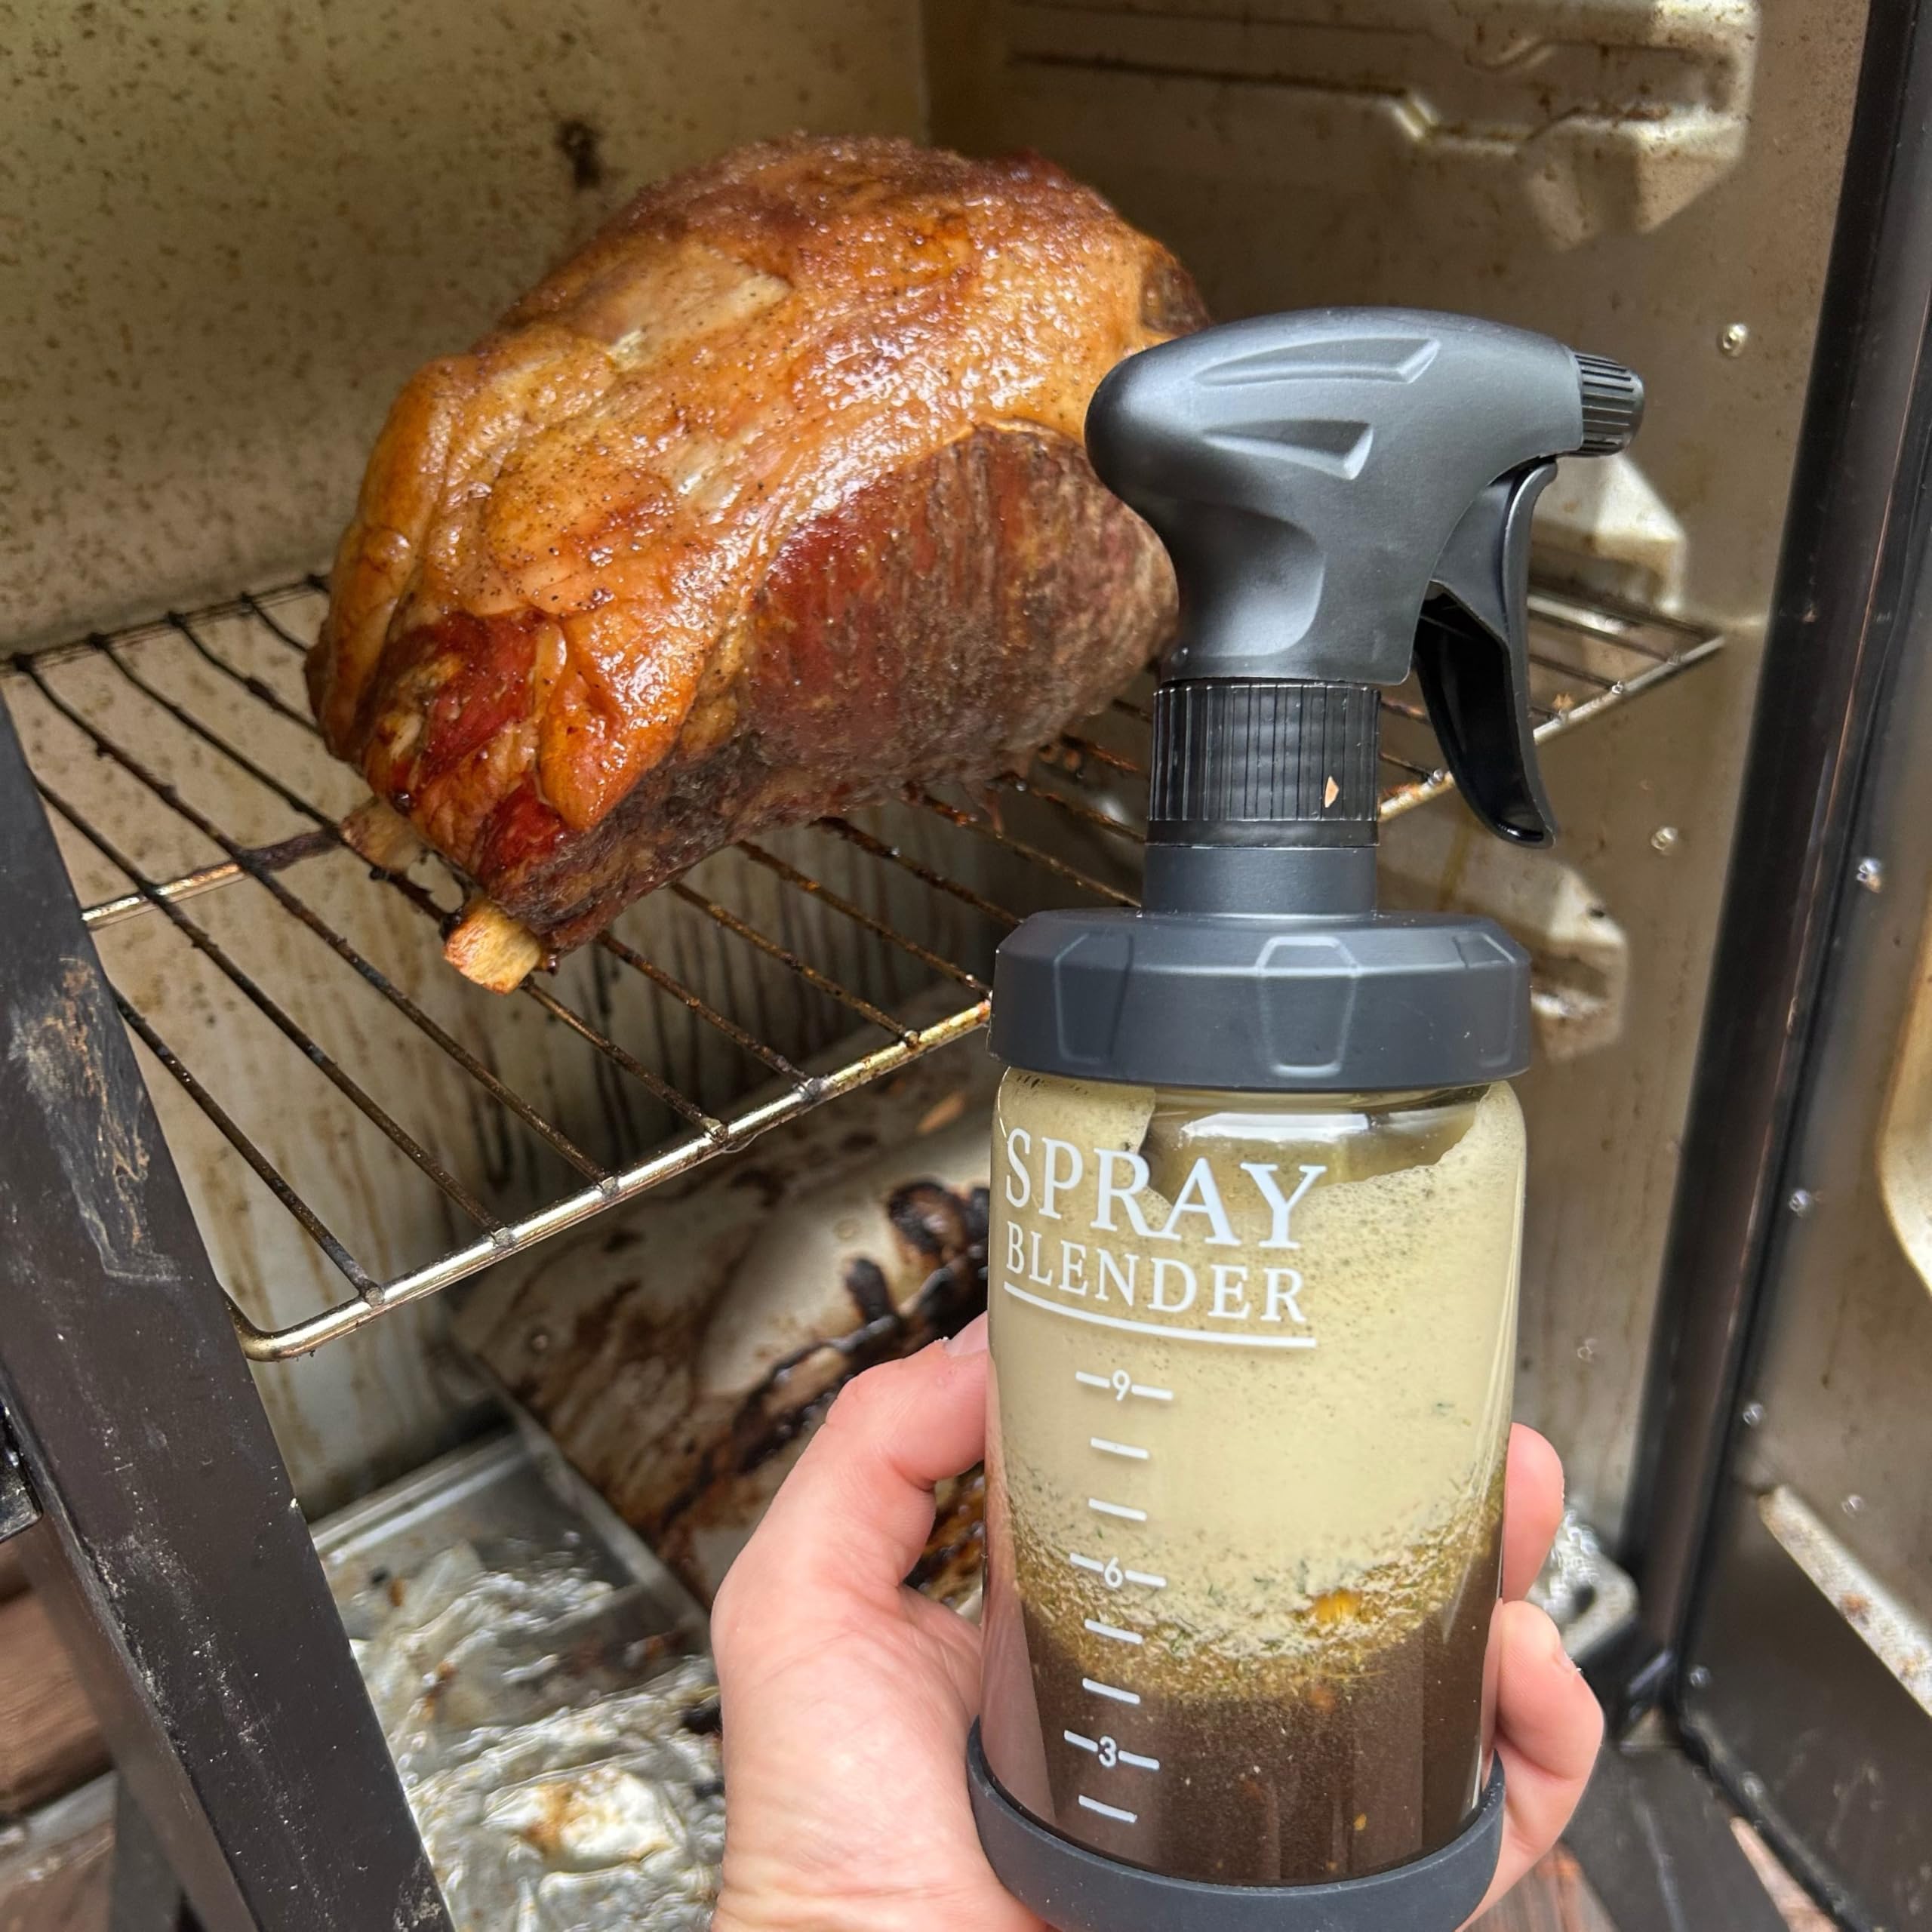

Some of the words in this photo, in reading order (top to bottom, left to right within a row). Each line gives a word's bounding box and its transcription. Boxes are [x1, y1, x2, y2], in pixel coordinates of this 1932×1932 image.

[1005, 1127, 1327, 1250] SPRAY
[1005, 1220, 1307, 1323] BLENDER
[1111, 1369, 1131, 1401] 9
[1103, 1556, 1124, 1589] 6
[1097, 1735, 1117, 1768] 3
